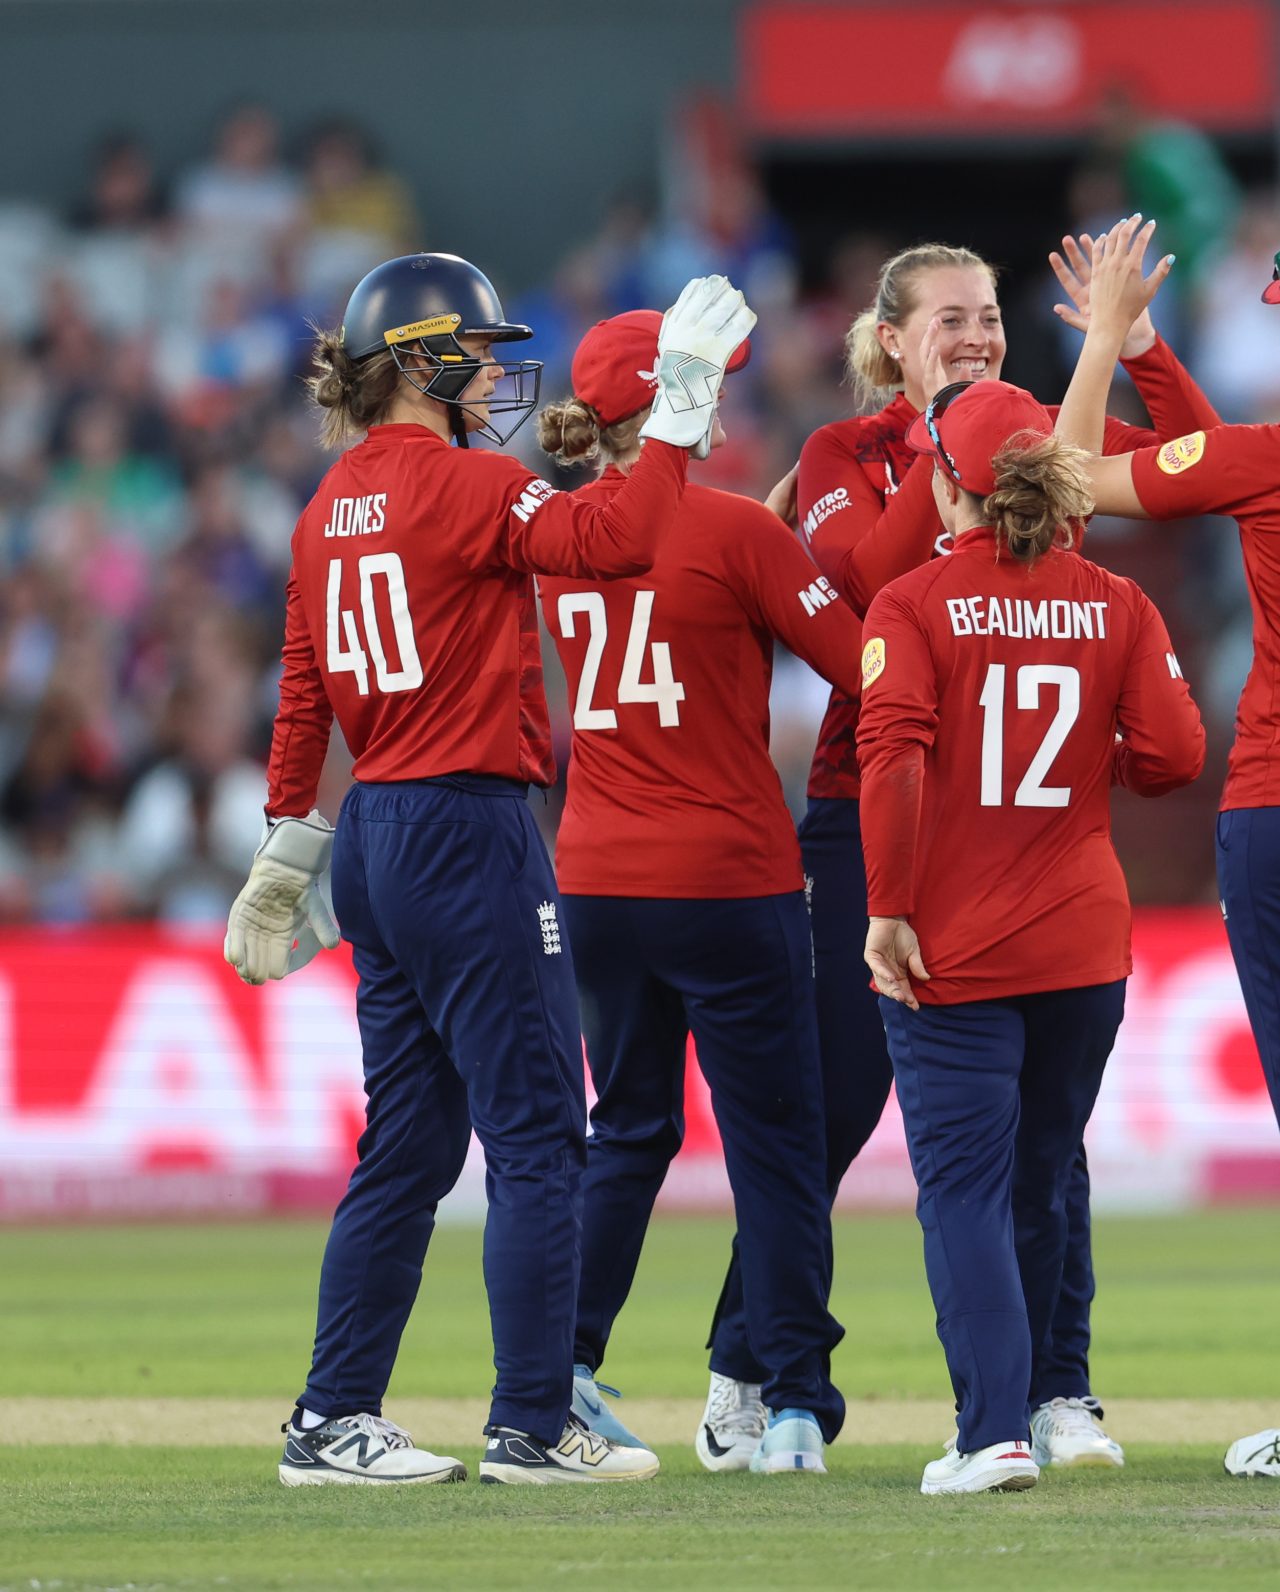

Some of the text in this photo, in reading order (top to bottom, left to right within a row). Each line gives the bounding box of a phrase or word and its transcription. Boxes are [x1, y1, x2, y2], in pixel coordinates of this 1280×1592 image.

[408, 320, 447, 333] MASURI
[1164, 444, 1185, 468] HOOPS
[324, 492, 387, 538] JONES
[803, 487, 848, 545] METRO
[817, 497, 853, 524] BANK
[325, 552, 425, 696] 40
[945, 595, 1109, 640] BEAUMONT
[557, 589, 686, 731] 24
[979, 663, 1081, 808] 12
